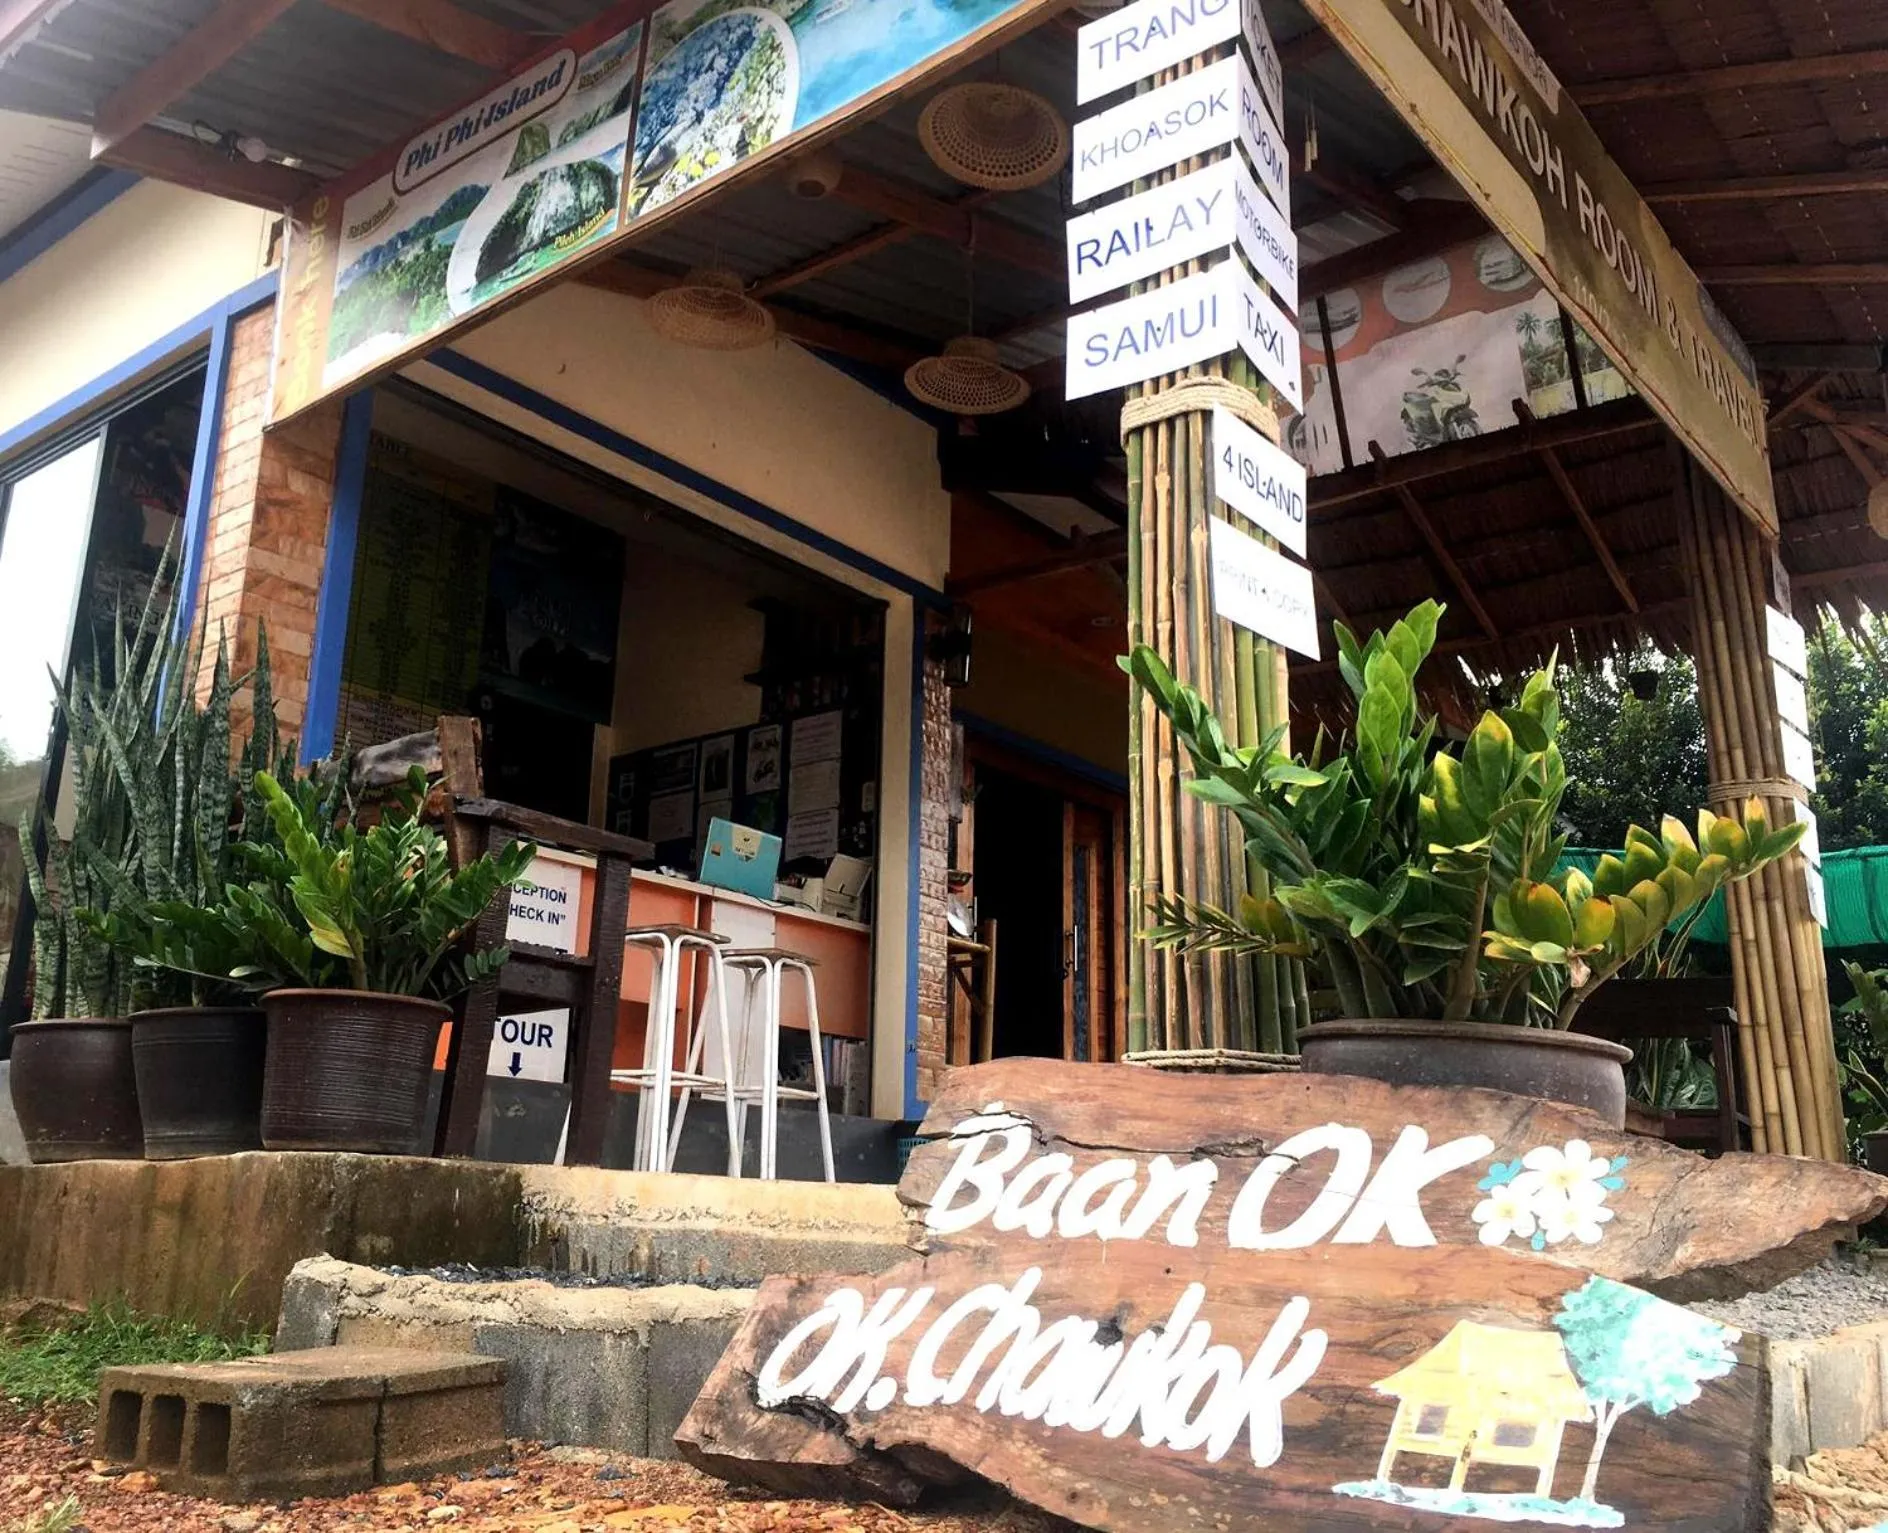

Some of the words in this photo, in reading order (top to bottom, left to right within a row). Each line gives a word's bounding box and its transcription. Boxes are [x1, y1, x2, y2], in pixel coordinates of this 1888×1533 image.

[404, 133, 443, 177] Phi
[444, 108, 485, 153] Phi
[484, 59, 567, 128] Island
[1079, 88, 1230, 173] KHOASOK
[1240, 84, 1284, 194] ROOM
[1402, 0, 1568, 211] HAWKOH
[1574, 170, 1661, 328] ROOM
[1076, 189, 1223, 276] RAILAY
[1235, 178, 1295, 282] MOTORBIKE
[1084, 294, 1218, 368] SAMUI
[1243, 292, 1285, 368] TAXI
[1222, 444, 1234, 473] 4
[1237, 452, 1304, 523] ISLAND
[509, 903, 545, 922] HECK
[513, 883, 567, 904] CEPTION
[495, 1017, 554, 1048] OUR
[926, 1101, 1219, 1248] Baan
[1227, 1122, 1495, 1250] OK
